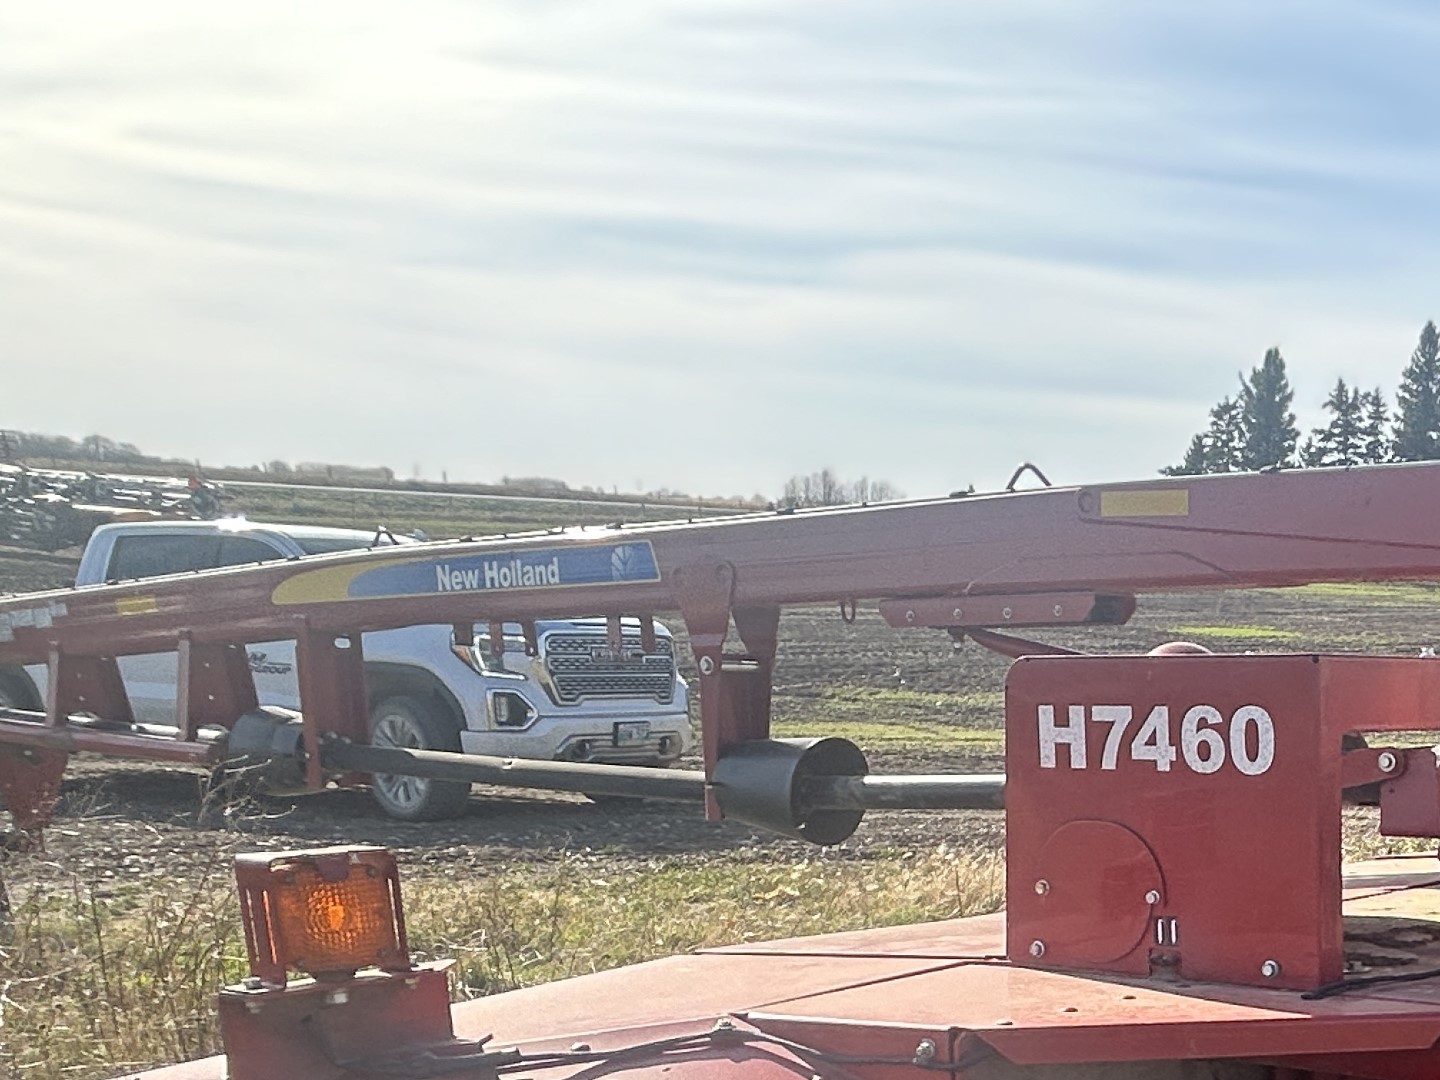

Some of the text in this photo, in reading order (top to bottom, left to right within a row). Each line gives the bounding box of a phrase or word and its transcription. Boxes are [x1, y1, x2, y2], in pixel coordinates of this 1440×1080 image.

[436, 557, 559, 592] New Holland
[1037, 704, 1275, 776] H7460
